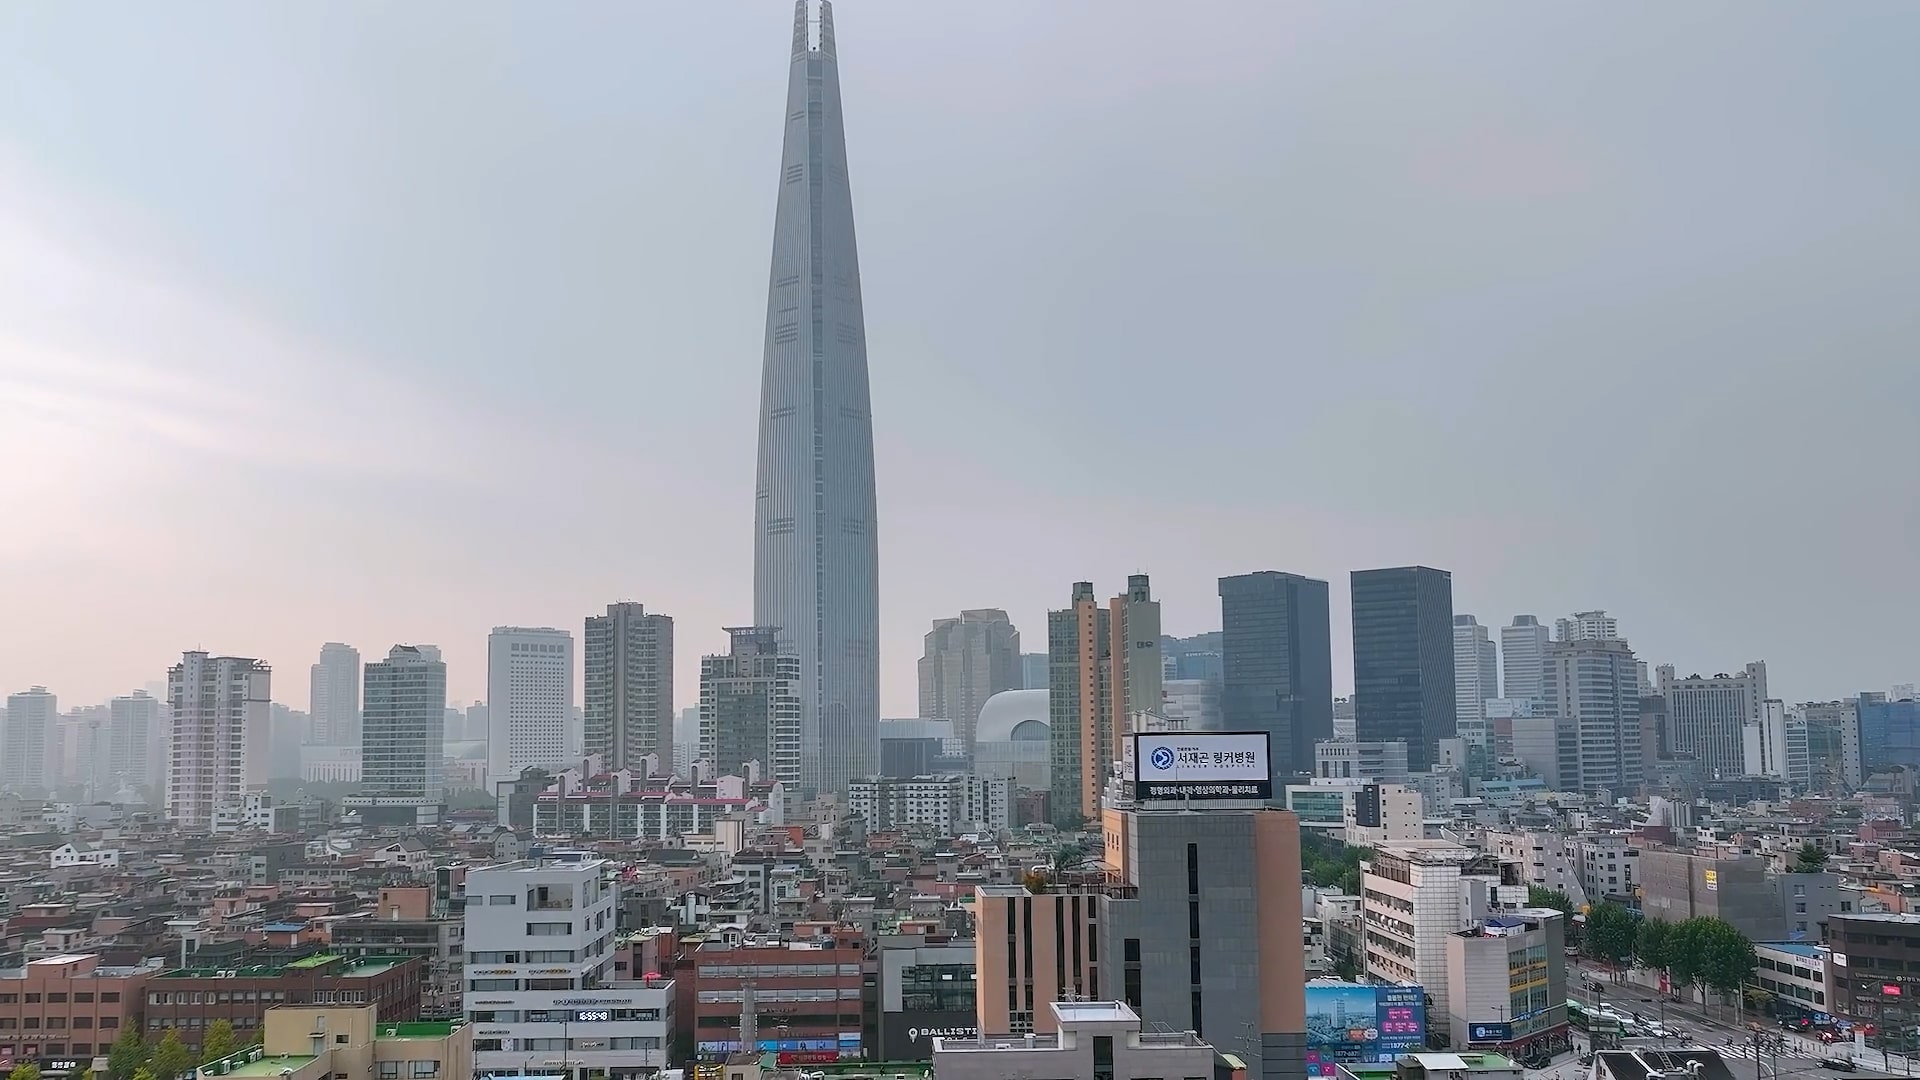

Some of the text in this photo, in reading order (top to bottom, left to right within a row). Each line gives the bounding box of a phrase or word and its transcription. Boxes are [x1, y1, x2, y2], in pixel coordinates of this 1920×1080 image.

[1177, 751, 1256, 765] 서재곤 링커병원
[921, 1027, 978, 1036] BALLISTI
